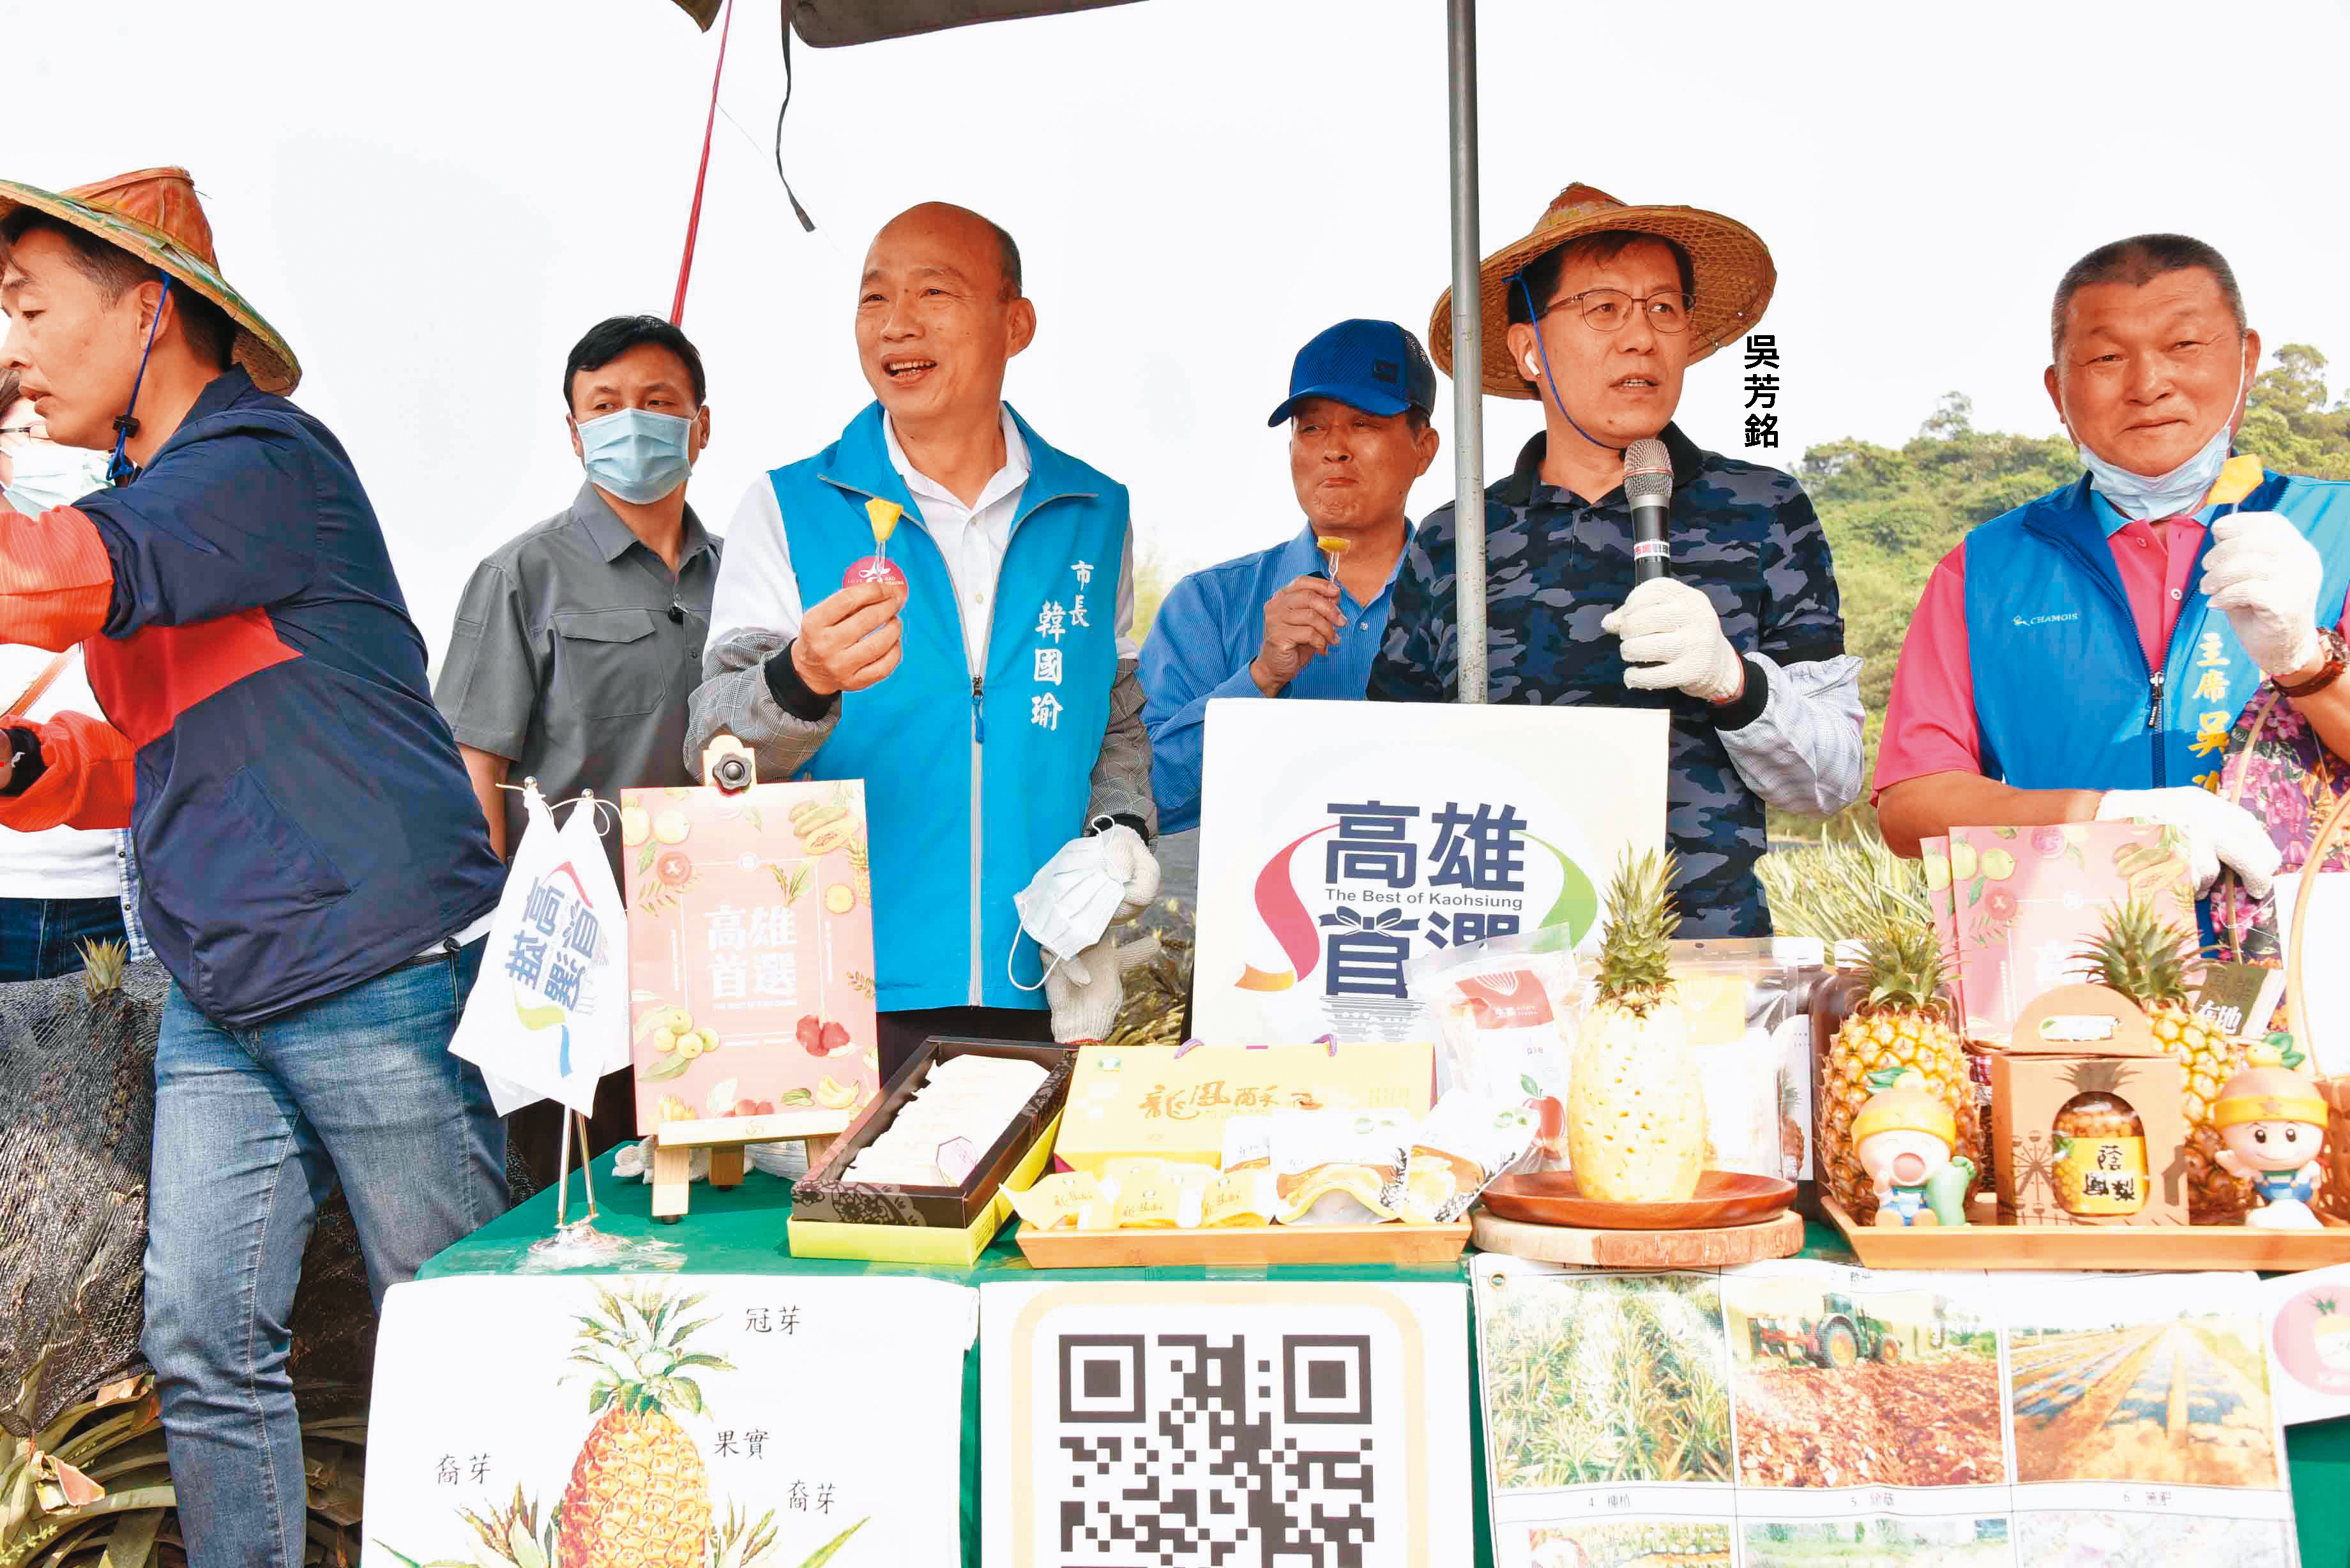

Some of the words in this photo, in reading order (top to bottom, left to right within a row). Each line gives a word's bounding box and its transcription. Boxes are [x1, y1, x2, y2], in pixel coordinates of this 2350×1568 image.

[1070, 560, 1094, 628] 市長
[2030, 613, 2078, 624] CHAMOIS
[1031, 599, 1067, 731] 韓國瑜
[1326, 801, 1527, 891] 高雄
[1325, 888, 1357, 901] The
[1363, 890, 1402, 904] Best
[1407, 893, 1424, 905] of
[1429, 893, 1523, 911] Kaohsiung
[704, 903, 798, 951] 高雄
[706, 950, 798, 1000] 首選
[745, 1305, 801, 1334] 冠芽
[713, 1428, 770, 1459] 果實
[436, 1453, 492, 1485] 裔芽
[787, 1479, 837, 1514] 裔芽
